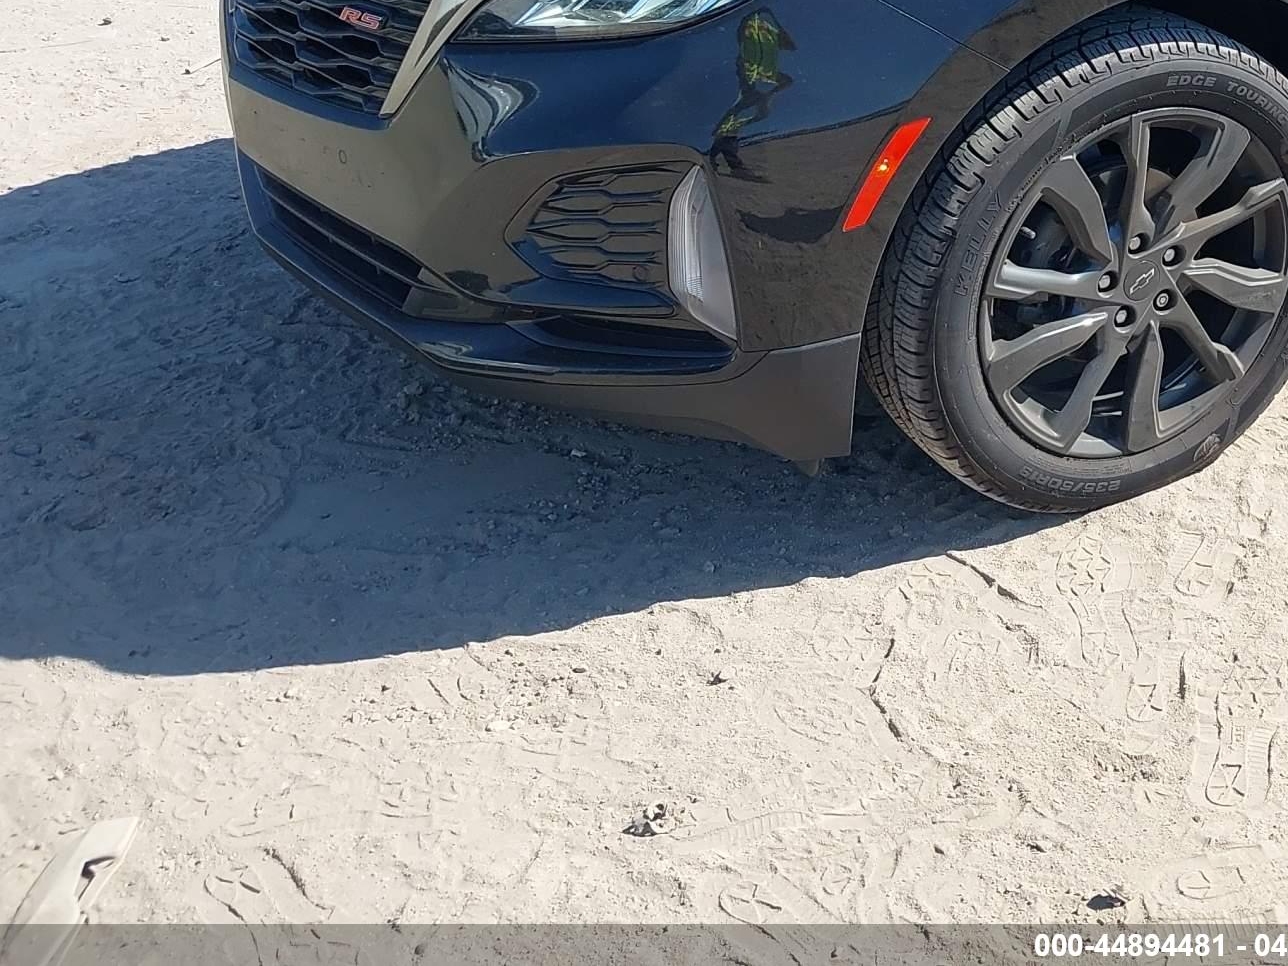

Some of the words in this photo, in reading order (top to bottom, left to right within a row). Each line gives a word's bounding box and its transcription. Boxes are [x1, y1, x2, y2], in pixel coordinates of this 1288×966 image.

[340, 6, 382, 29] RS
[1166, 75, 1217, 87] EDGE
[1226, 81, 1288, 126] TOURING
